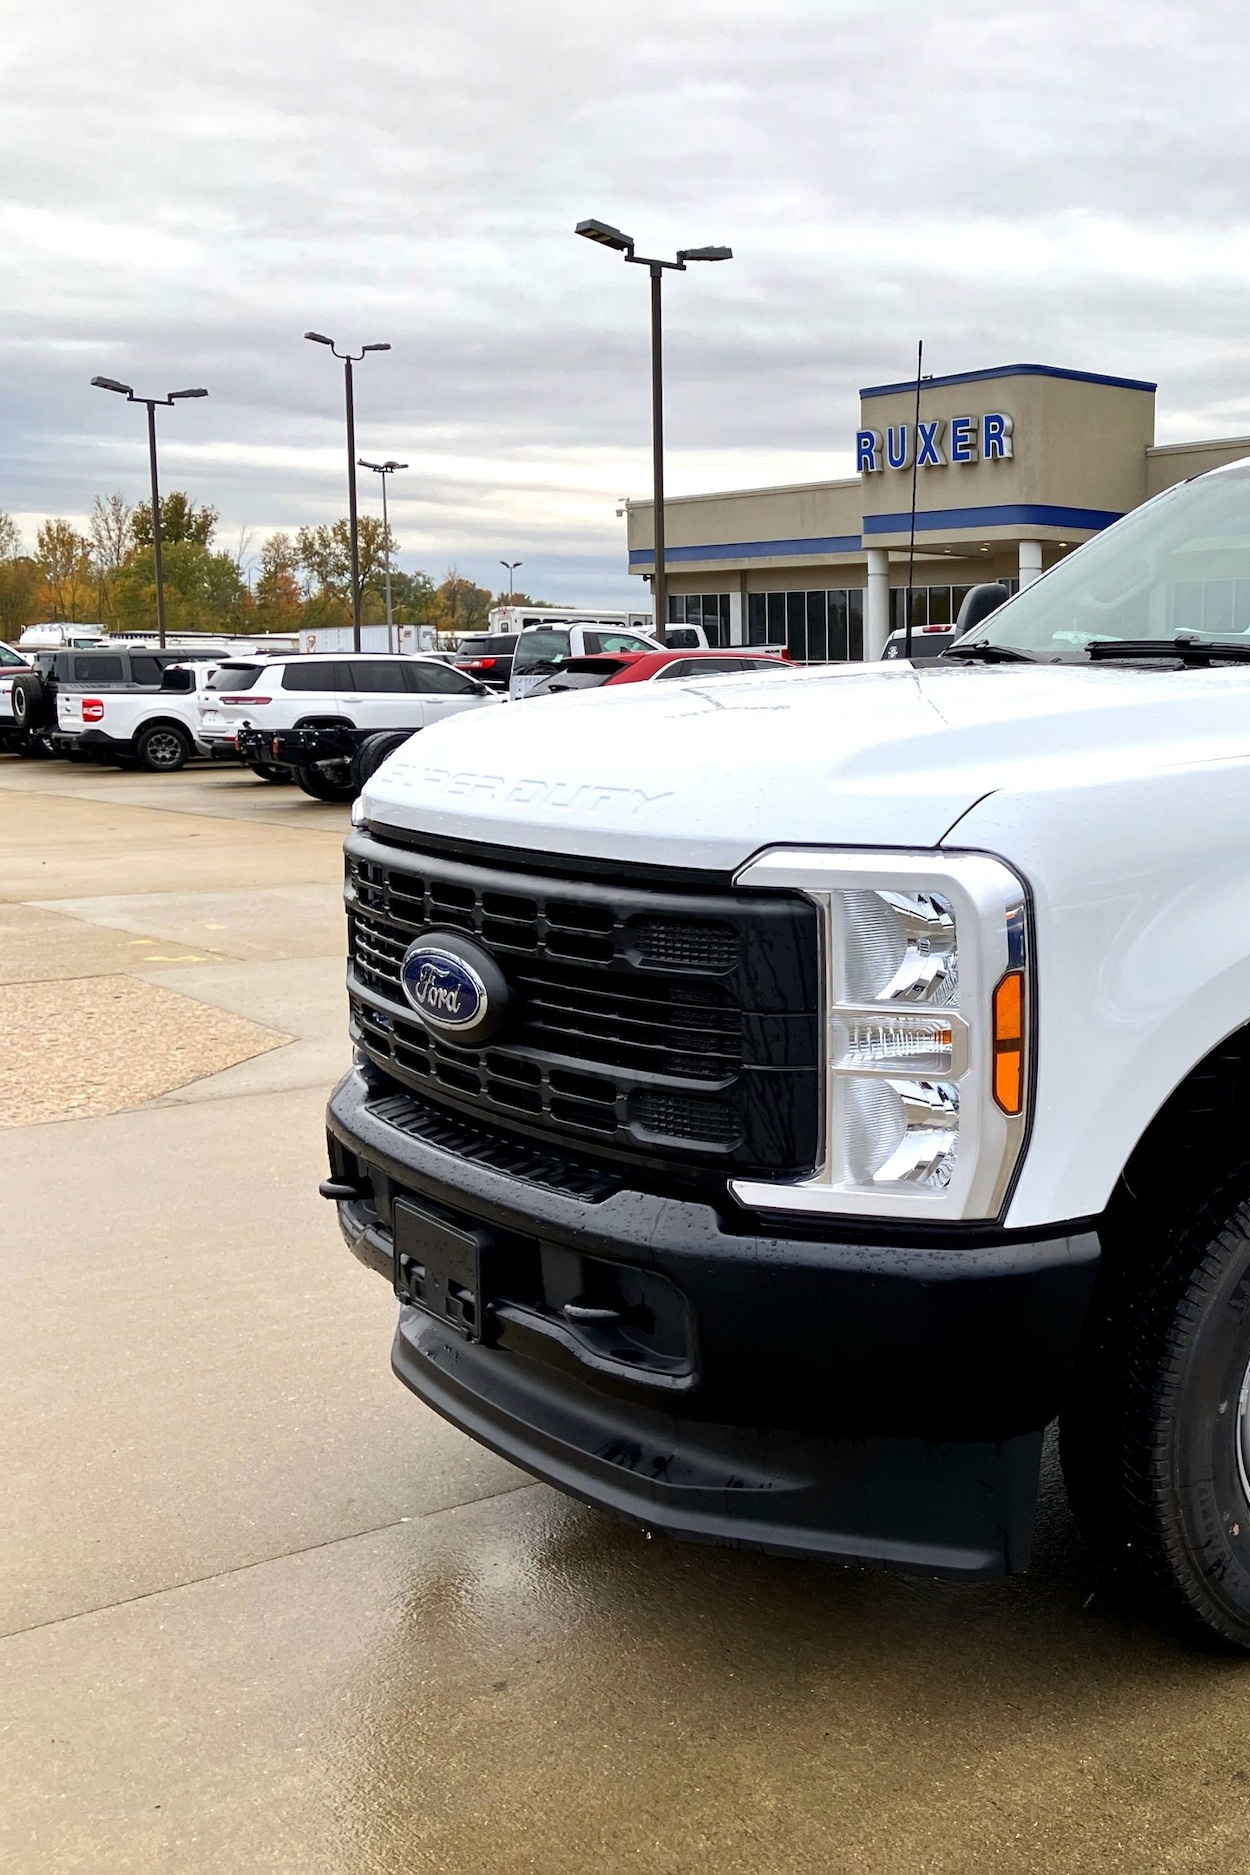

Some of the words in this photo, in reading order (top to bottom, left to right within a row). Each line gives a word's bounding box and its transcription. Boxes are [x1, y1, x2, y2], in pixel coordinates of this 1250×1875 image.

[856, 413, 1014, 473] RUXER
[503, 778, 675, 819] DUTY
[415, 962, 462, 1013] Ford
